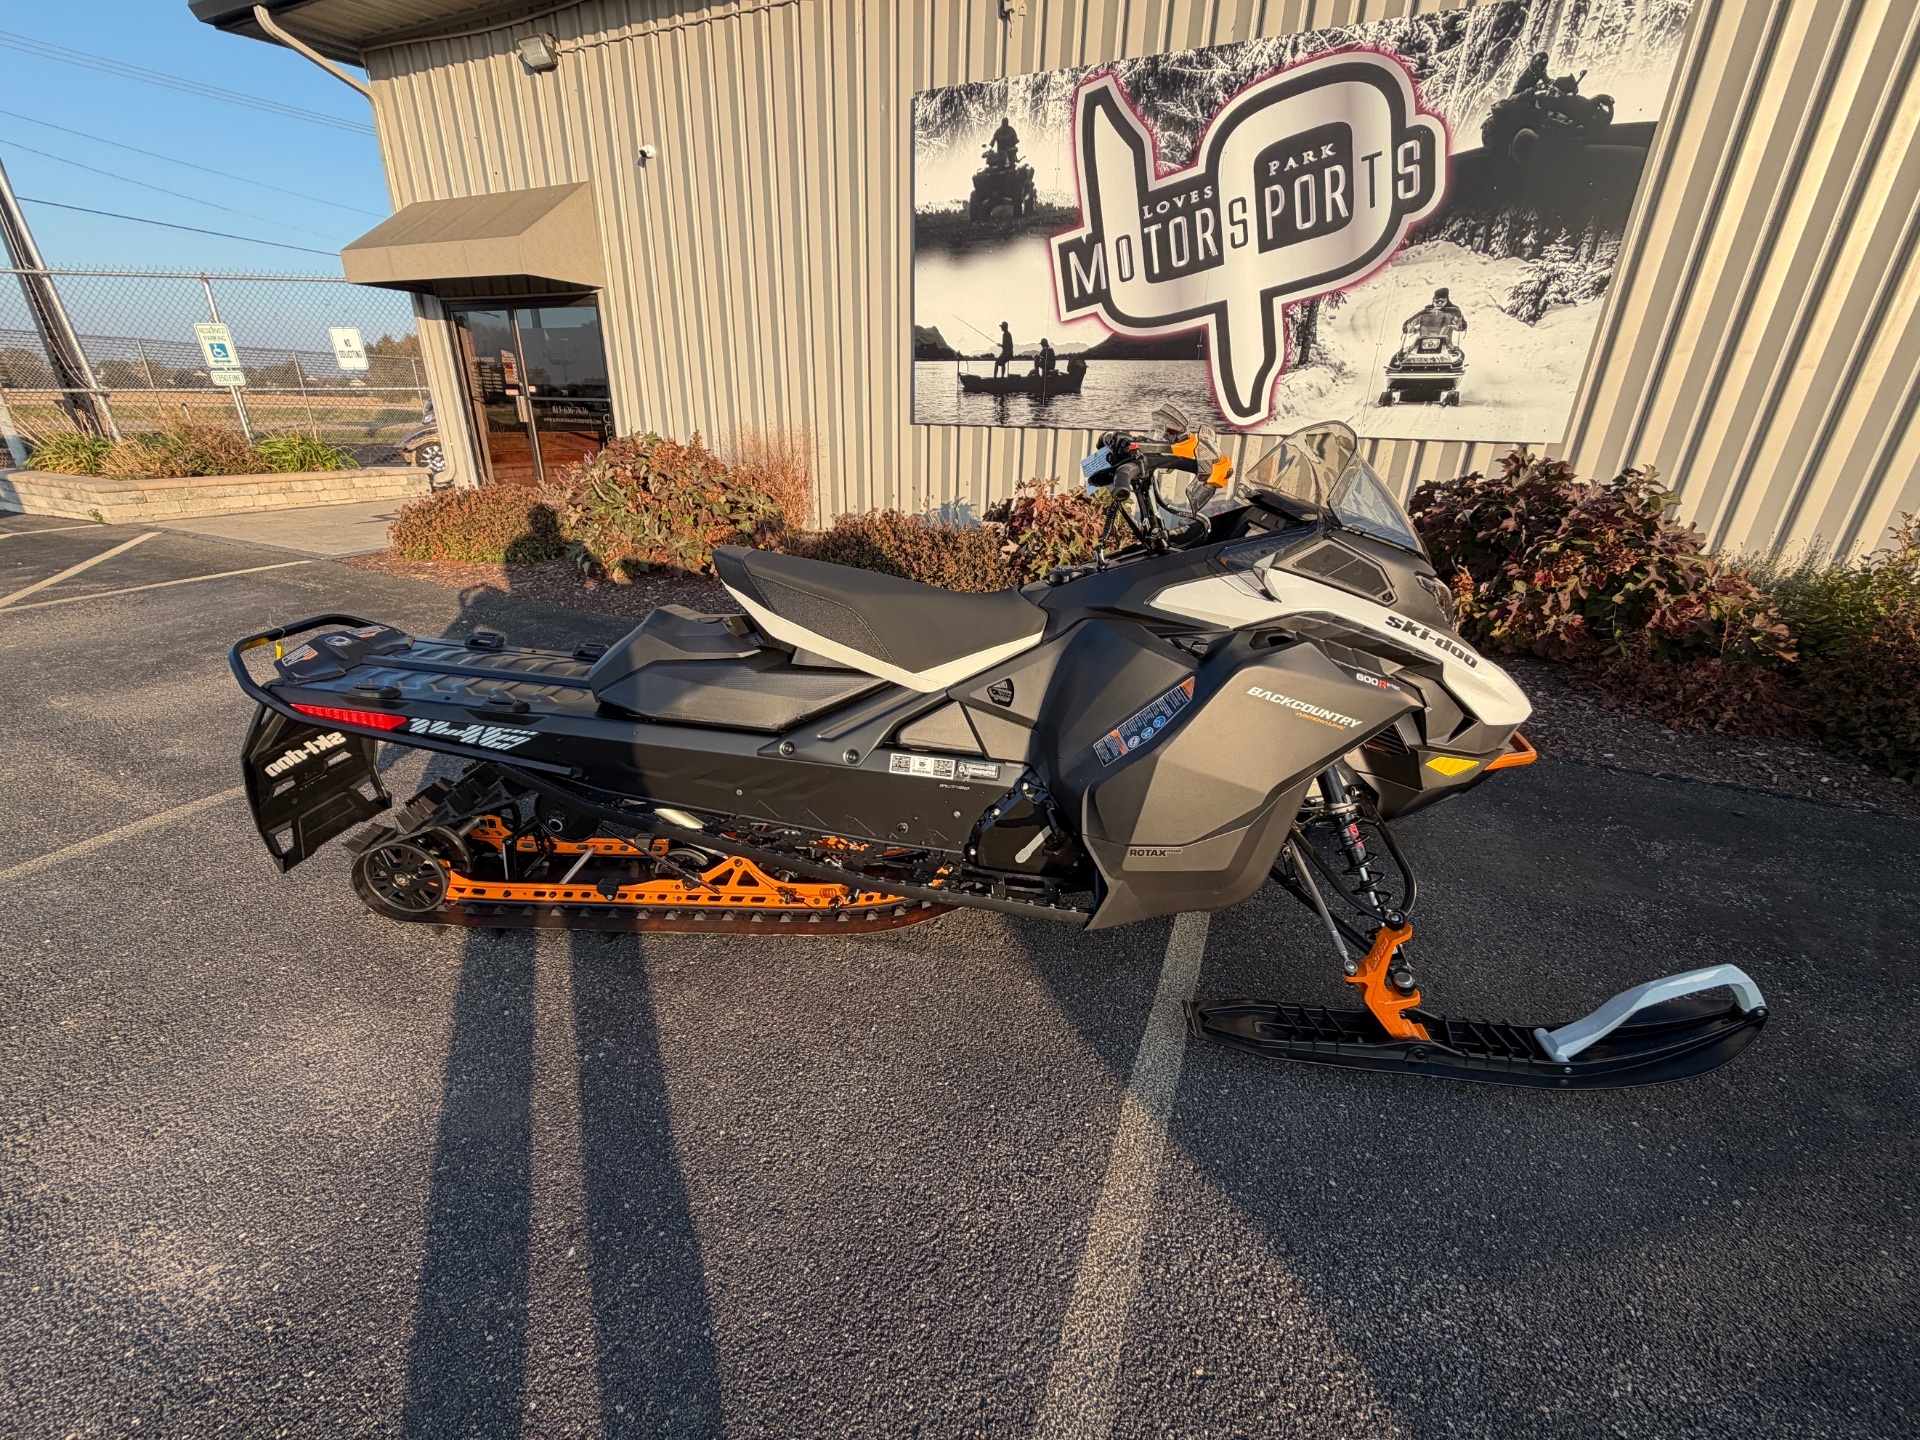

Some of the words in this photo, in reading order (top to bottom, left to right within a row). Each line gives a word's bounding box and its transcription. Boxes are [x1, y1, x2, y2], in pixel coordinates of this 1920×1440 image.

[1142, 185, 1214, 220] LOVES
[1268, 142, 1337, 176] PARK
[1068, 138, 1422, 299] MOTORSPORTS
[338, 350, 363, 359] SOLICITING
[343, 338, 352, 348] NO
[1384, 615, 1478, 669] ski-doo
[1246, 686, 1364, 729] BACKCOUNTRY
[1130, 849, 1167, 857] ROTAX
